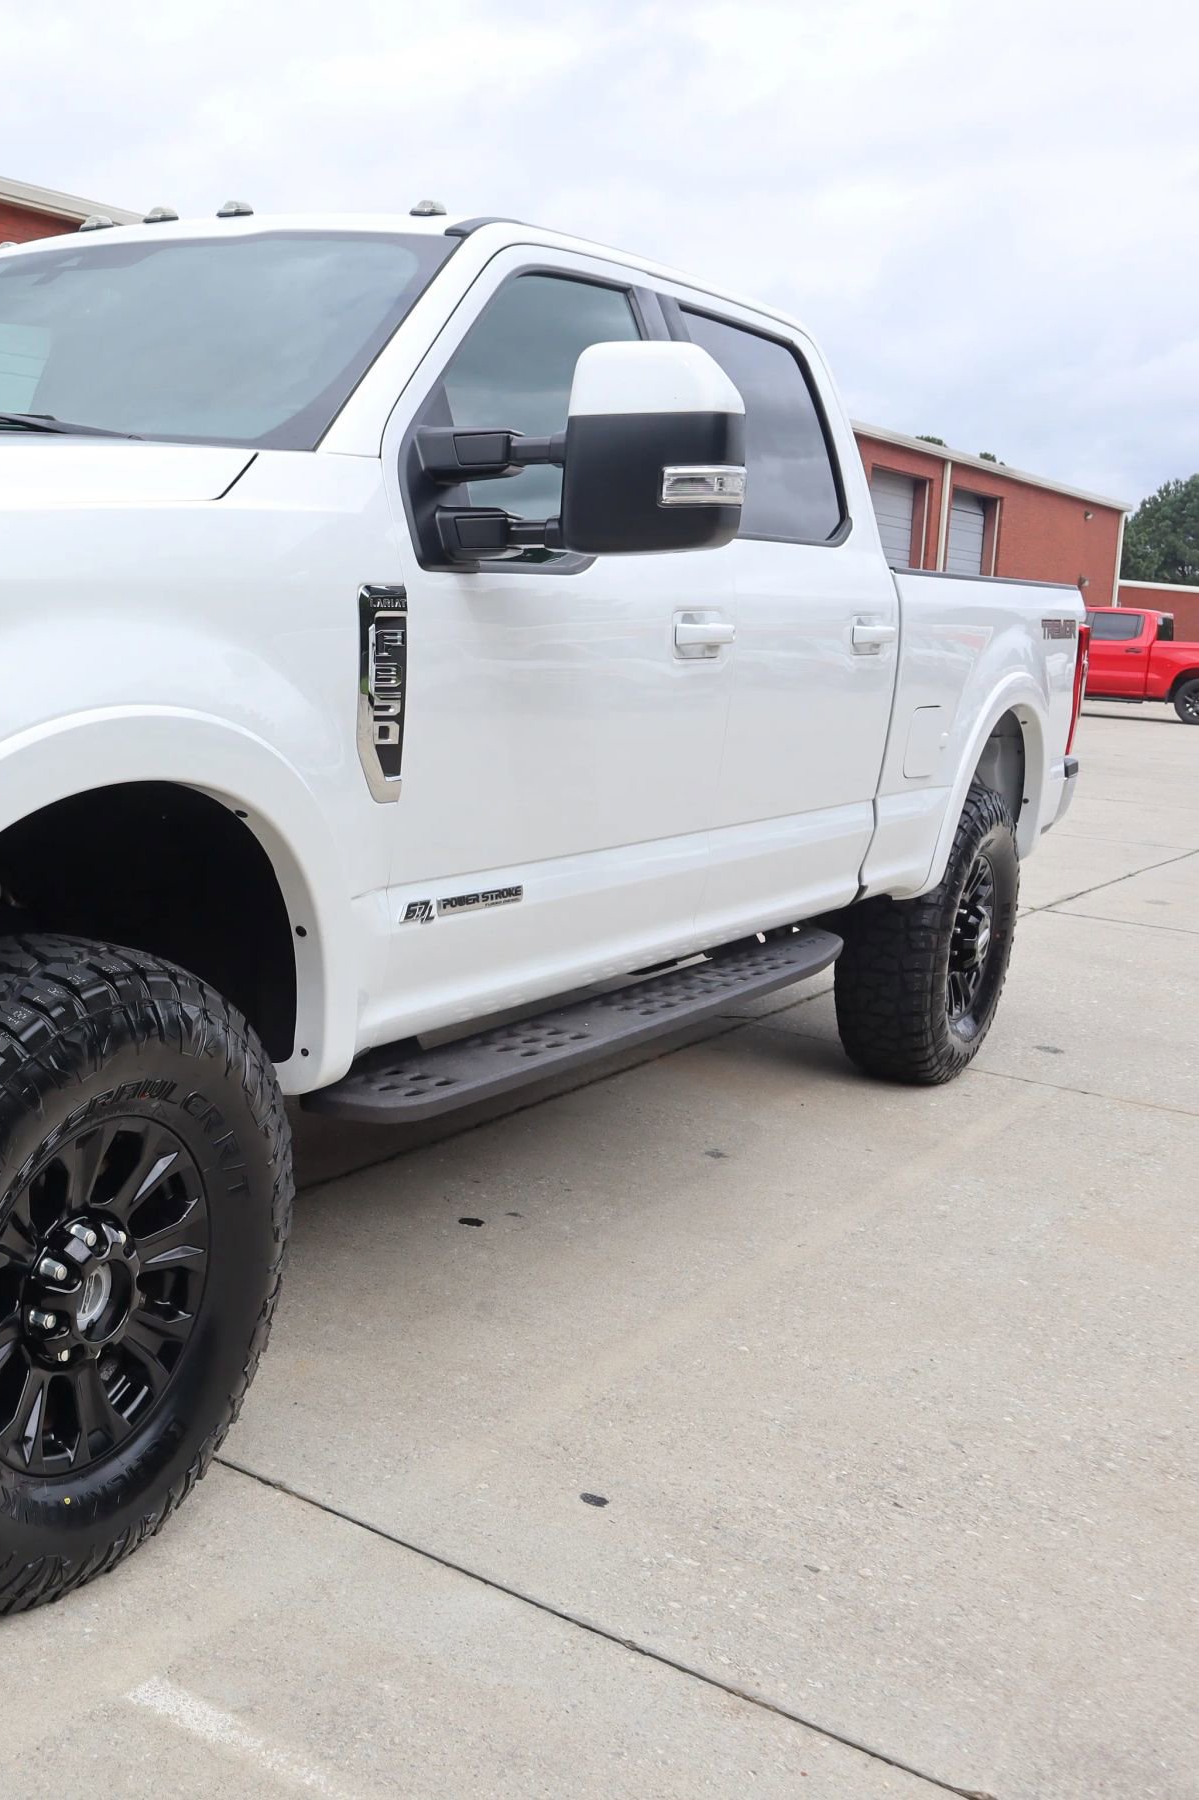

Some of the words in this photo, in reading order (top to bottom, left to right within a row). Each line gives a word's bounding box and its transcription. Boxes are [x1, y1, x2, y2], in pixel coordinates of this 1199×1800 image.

[369, 598, 406, 608] LARIAT
[1041, 618, 1076, 640] TREMOR
[442, 893, 481, 910] POWER
[481, 884, 522, 903] STROKE
